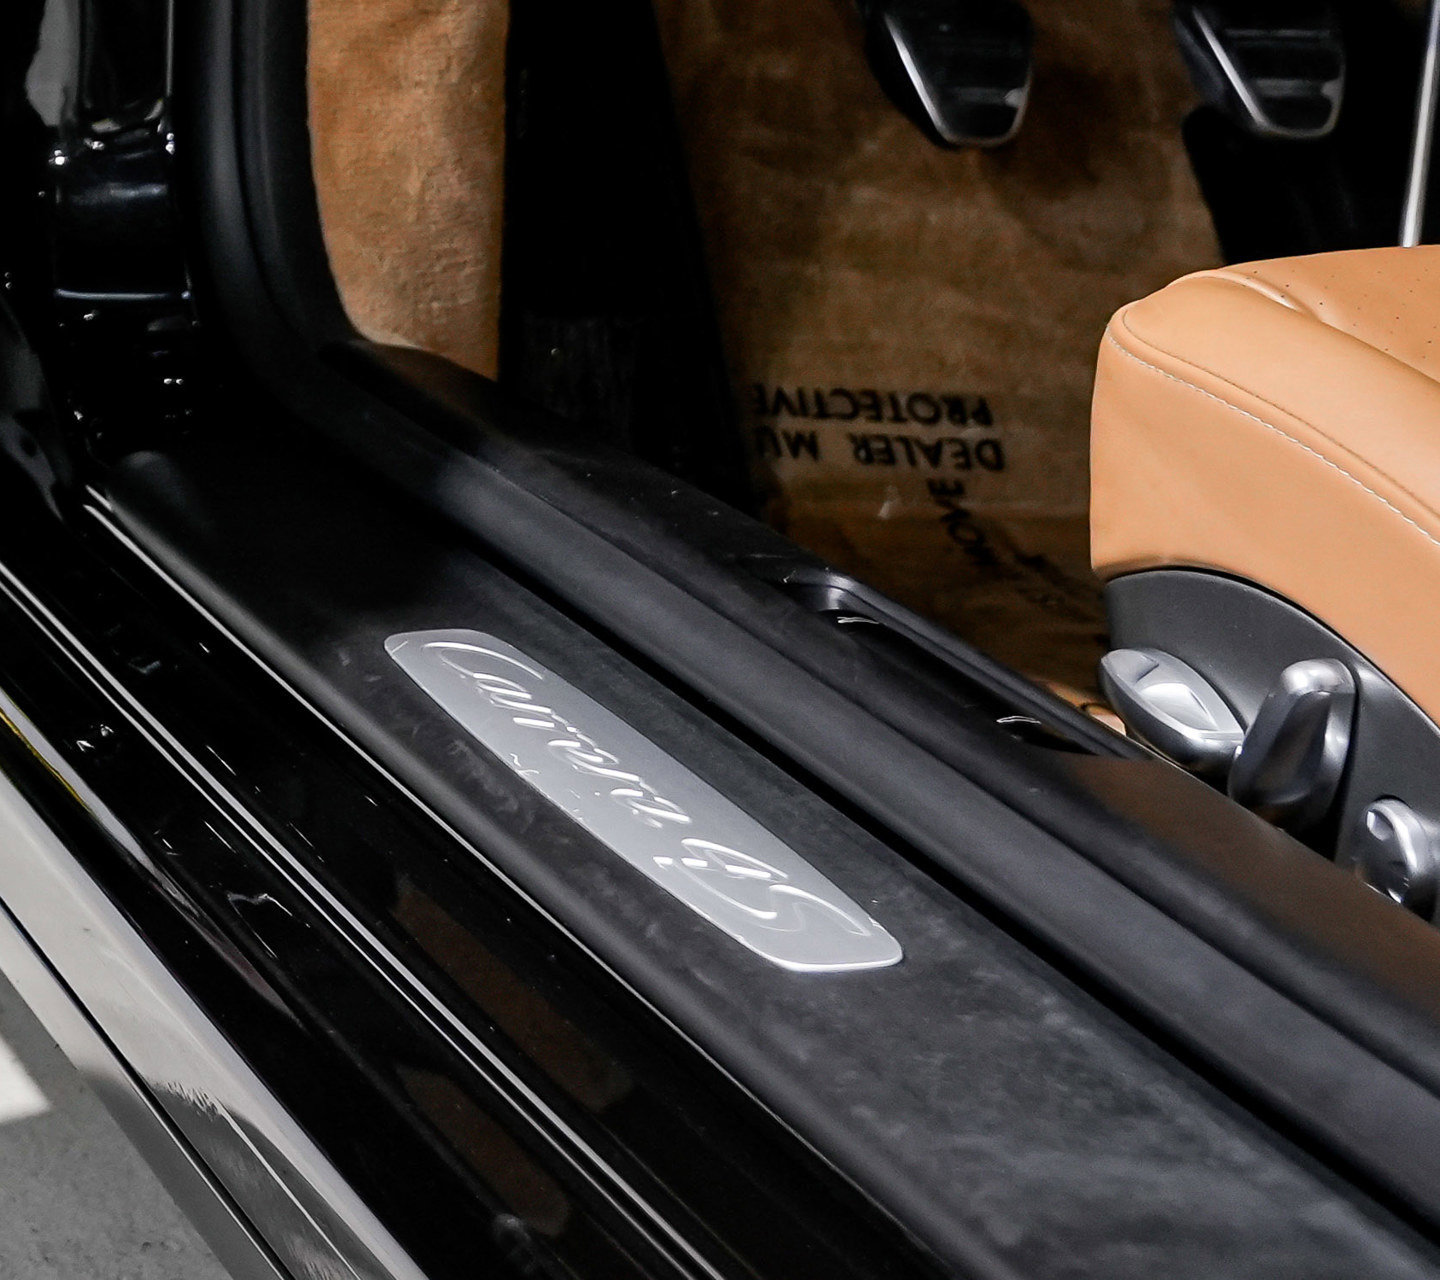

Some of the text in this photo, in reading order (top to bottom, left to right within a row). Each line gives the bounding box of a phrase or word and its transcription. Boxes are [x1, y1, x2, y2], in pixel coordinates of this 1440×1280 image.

[750, 381, 994, 428] PROTECTIVE
[850, 431, 1004, 472] DEALER
[420, 640, 691, 829] Carrera
